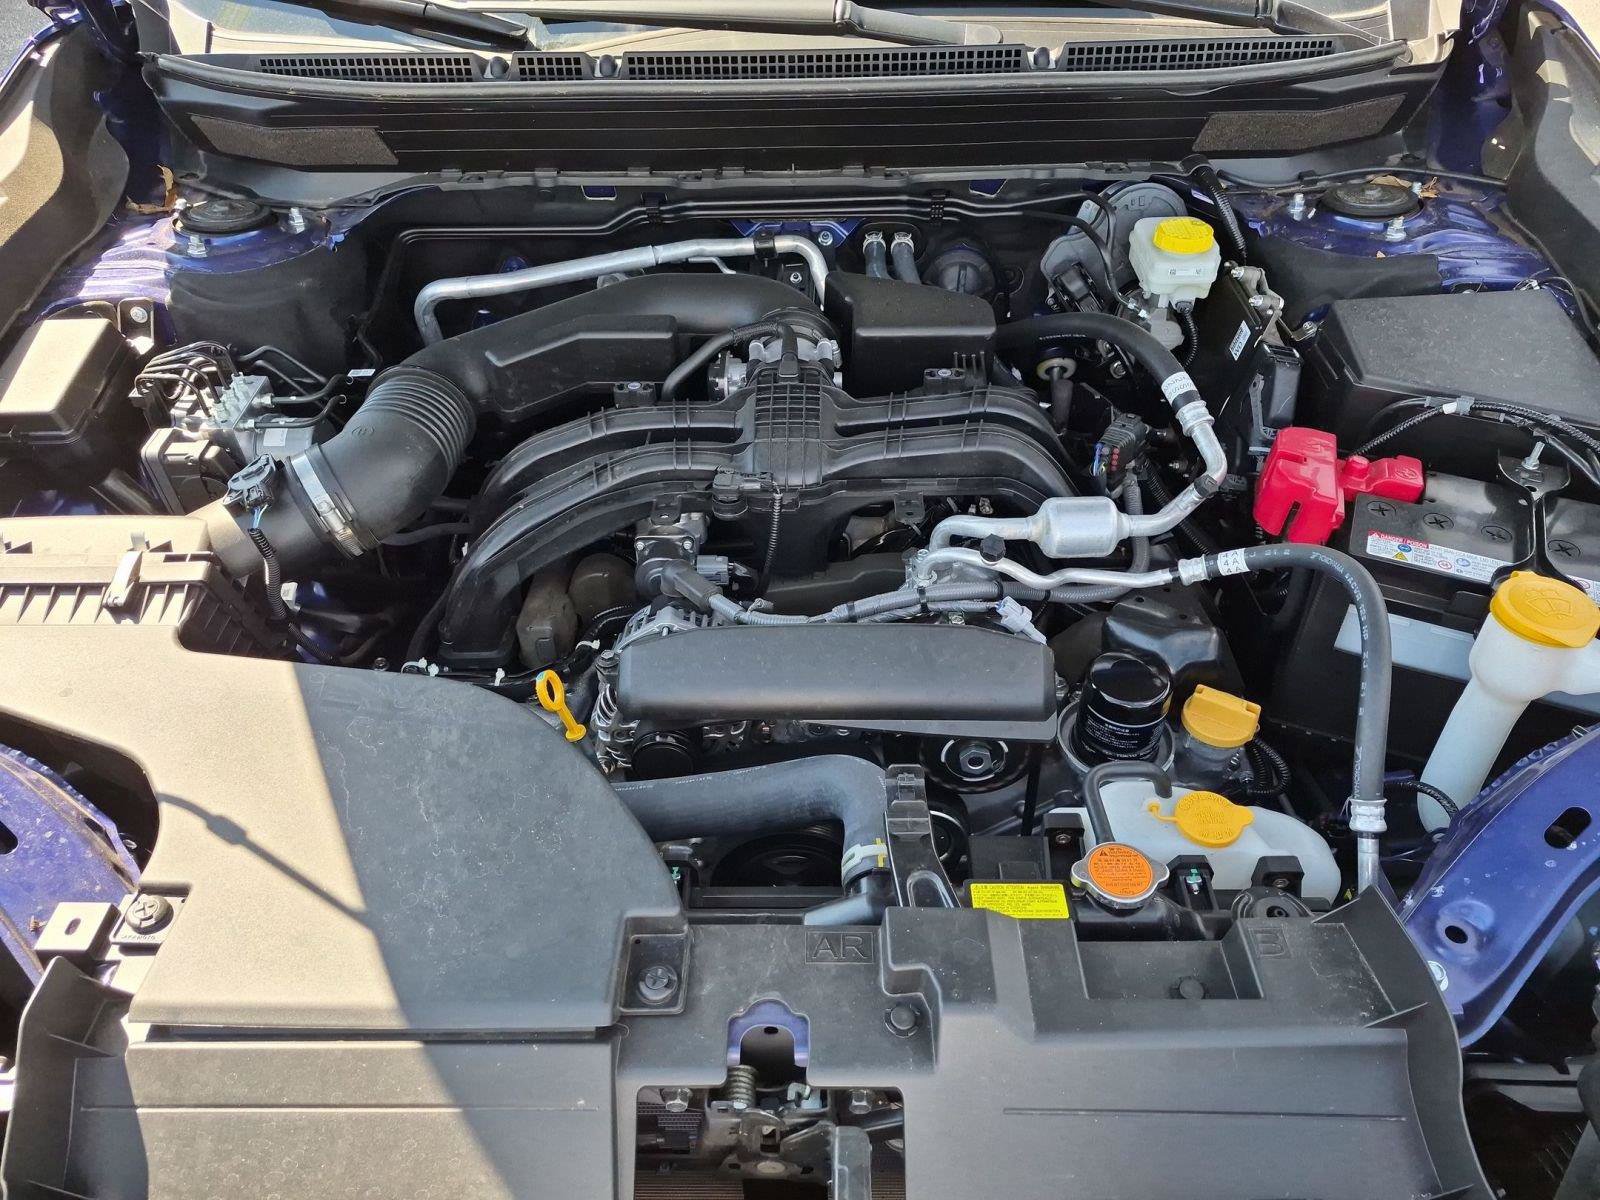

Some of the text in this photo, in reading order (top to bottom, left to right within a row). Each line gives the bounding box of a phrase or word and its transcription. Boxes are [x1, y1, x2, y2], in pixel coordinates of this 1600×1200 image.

[1380, 534, 1429, 549] DANGER POISON
[812, 935, 868, 959] AR
